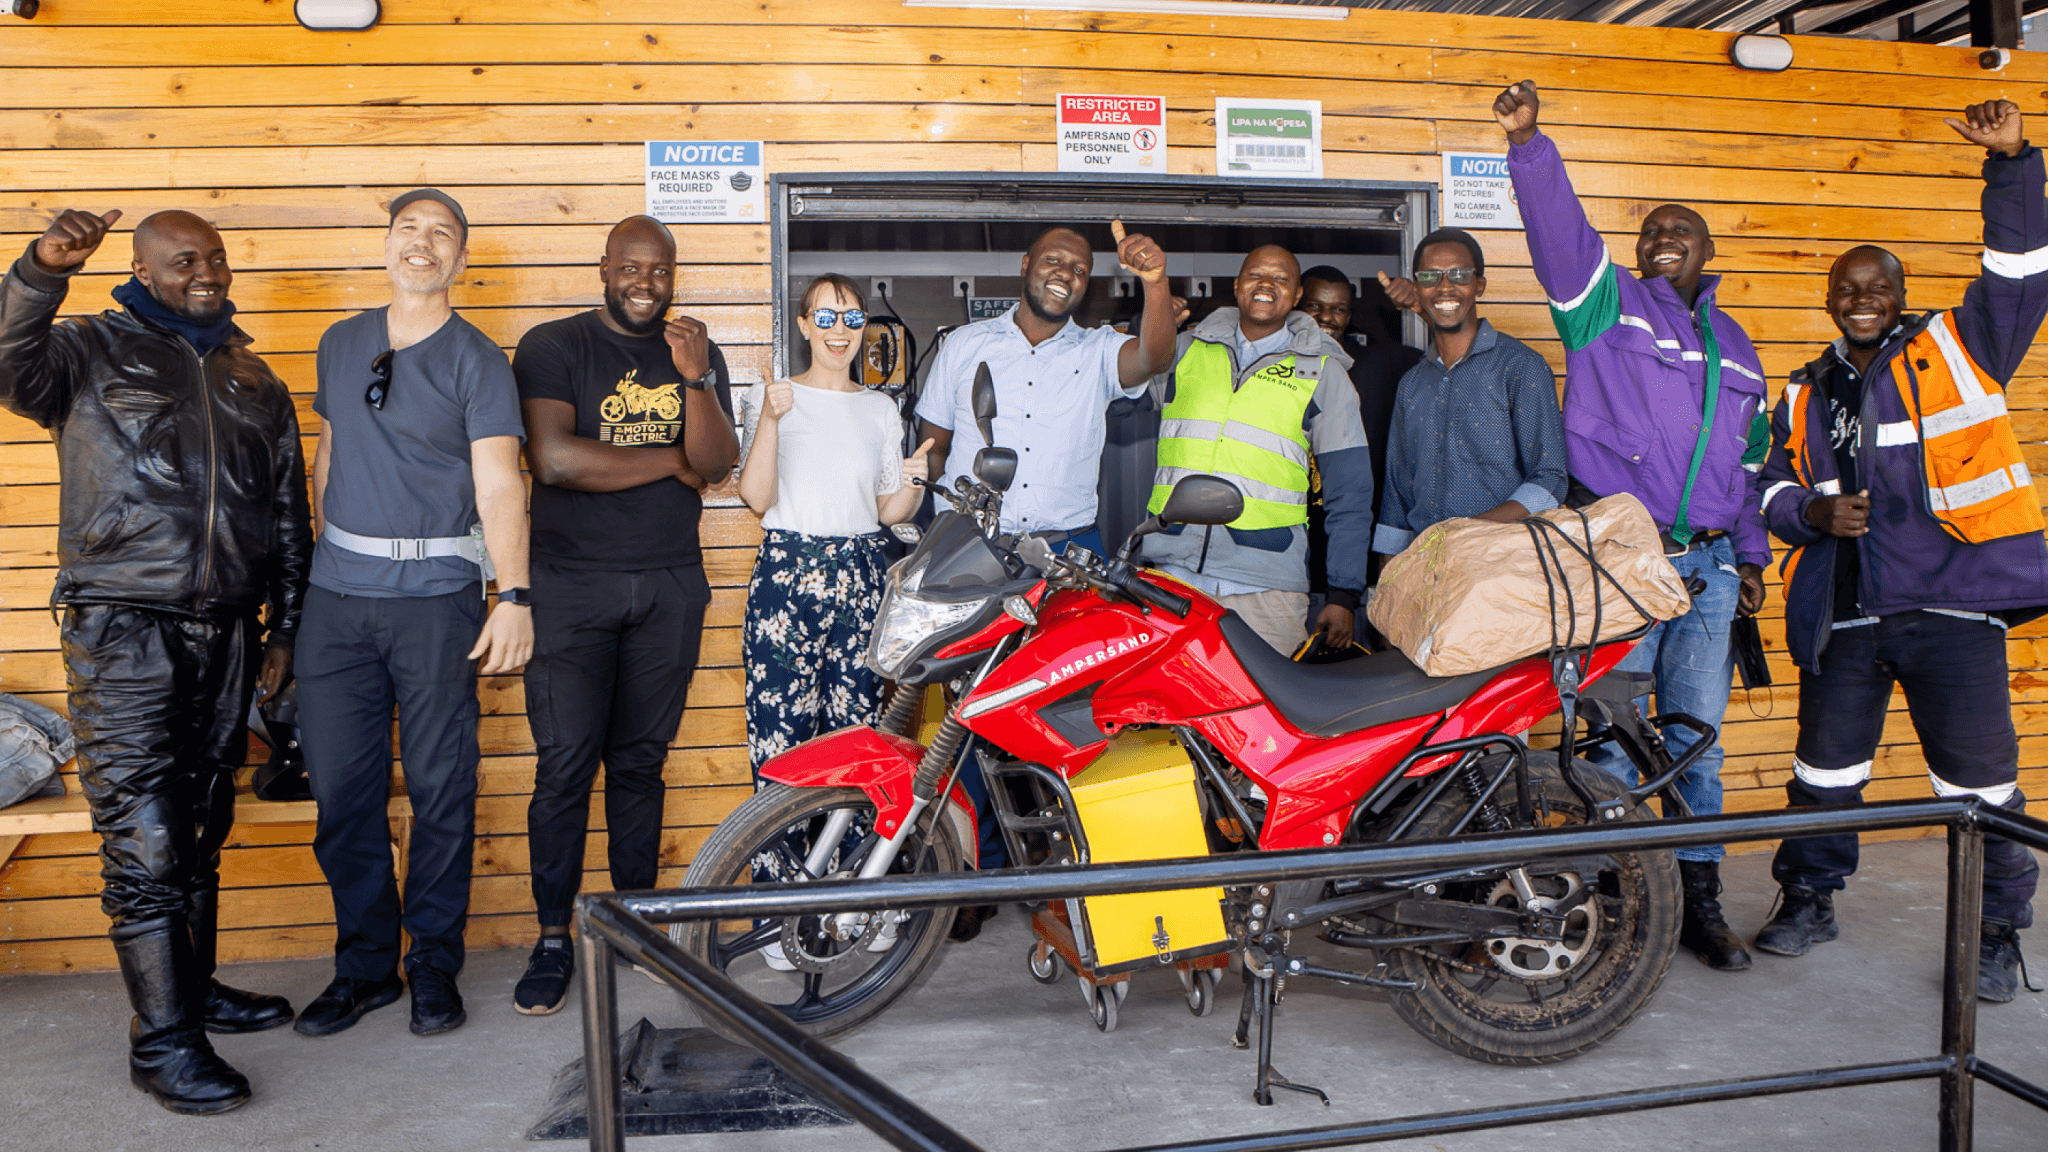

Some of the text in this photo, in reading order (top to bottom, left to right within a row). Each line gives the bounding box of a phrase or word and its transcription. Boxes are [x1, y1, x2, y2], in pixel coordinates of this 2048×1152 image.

[1065, 98, 1156, 111] RESTRICTED
[1091, 111, 1132, 123] AREA
[1231, 118, 1252, 127] LIPA
[1253, 118, 1267, 127] NA
[1064, 131, 1131, 140] AMPERSAND
[1065, 143, 1130, 153] PERSONNEL
[664, 145, 745, 163] NOTICE
[1084, 155, 1112, 165] ONLY
[1461, 159, 1509, 175] NOTIC
[651, 171, 720, 181] FACE MASKS
[659, 183, 713, 193] REQUIRED
[1467, 180, 1483, 188] NOT
[1486, 181, 1505, 189] TAKE
[1453, 189, 1495, 198] PICTURES!
[1453, 202, 1501, 211] NO CAMERA
[1454, 211, 1495, 220] ALLOWED!
[624, 424, 657, 434] MOTO
[613, 432, 667, 443] ELECTRIC
[1050, 632, 1150, 686] AMPERSAND
